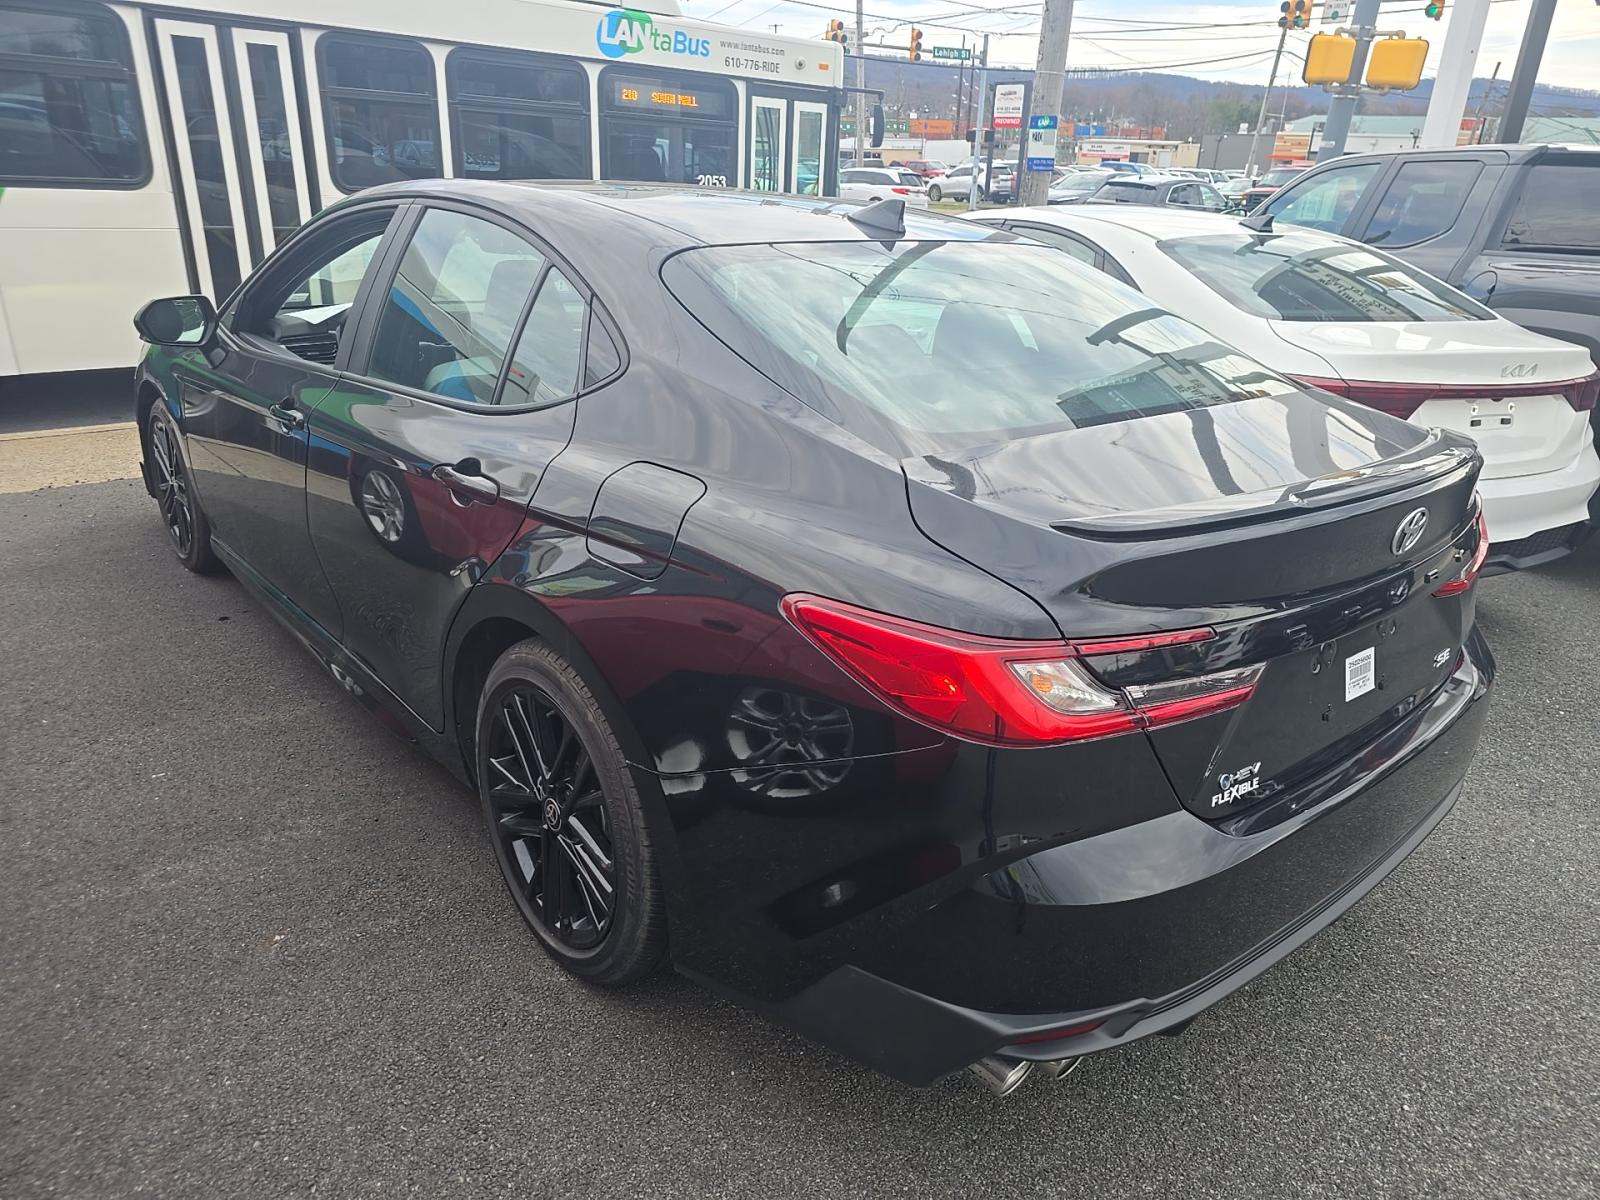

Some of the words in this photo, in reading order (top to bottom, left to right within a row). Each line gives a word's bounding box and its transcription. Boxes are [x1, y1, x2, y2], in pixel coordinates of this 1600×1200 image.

[934, 47, 959, 59] Lehigh
[724, 57, 781, 74] 610-776-RIDE
[696, 174, 727, 188] 2053
[1211, 777, 1260, 808] FLEXIBLE
